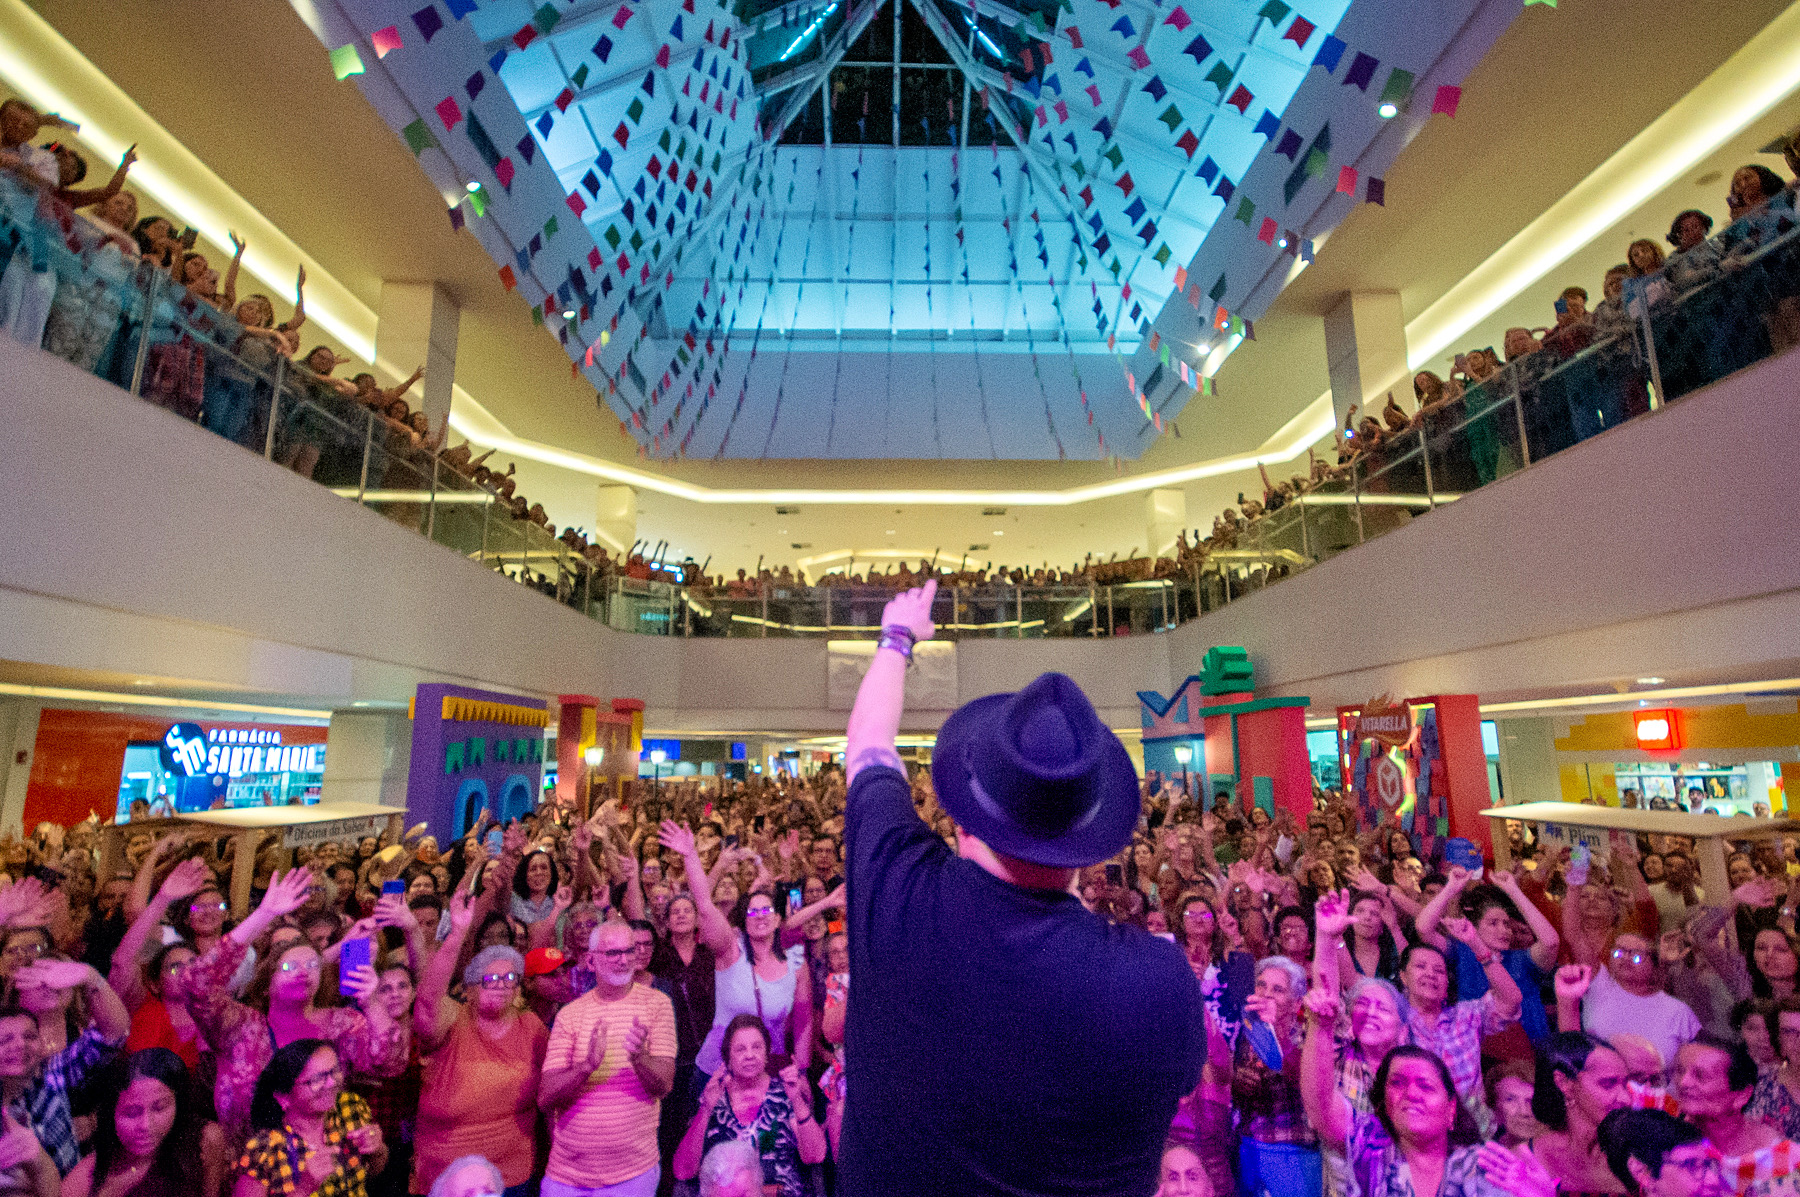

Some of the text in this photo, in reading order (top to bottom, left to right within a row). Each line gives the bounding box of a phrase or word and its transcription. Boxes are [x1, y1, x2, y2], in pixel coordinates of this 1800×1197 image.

[1361, 714, 1408, 732] VITARELLA
[208, 728, 282, 744] FARMÁCIA
[205, 745, 316, 774] SANTA MARIA
